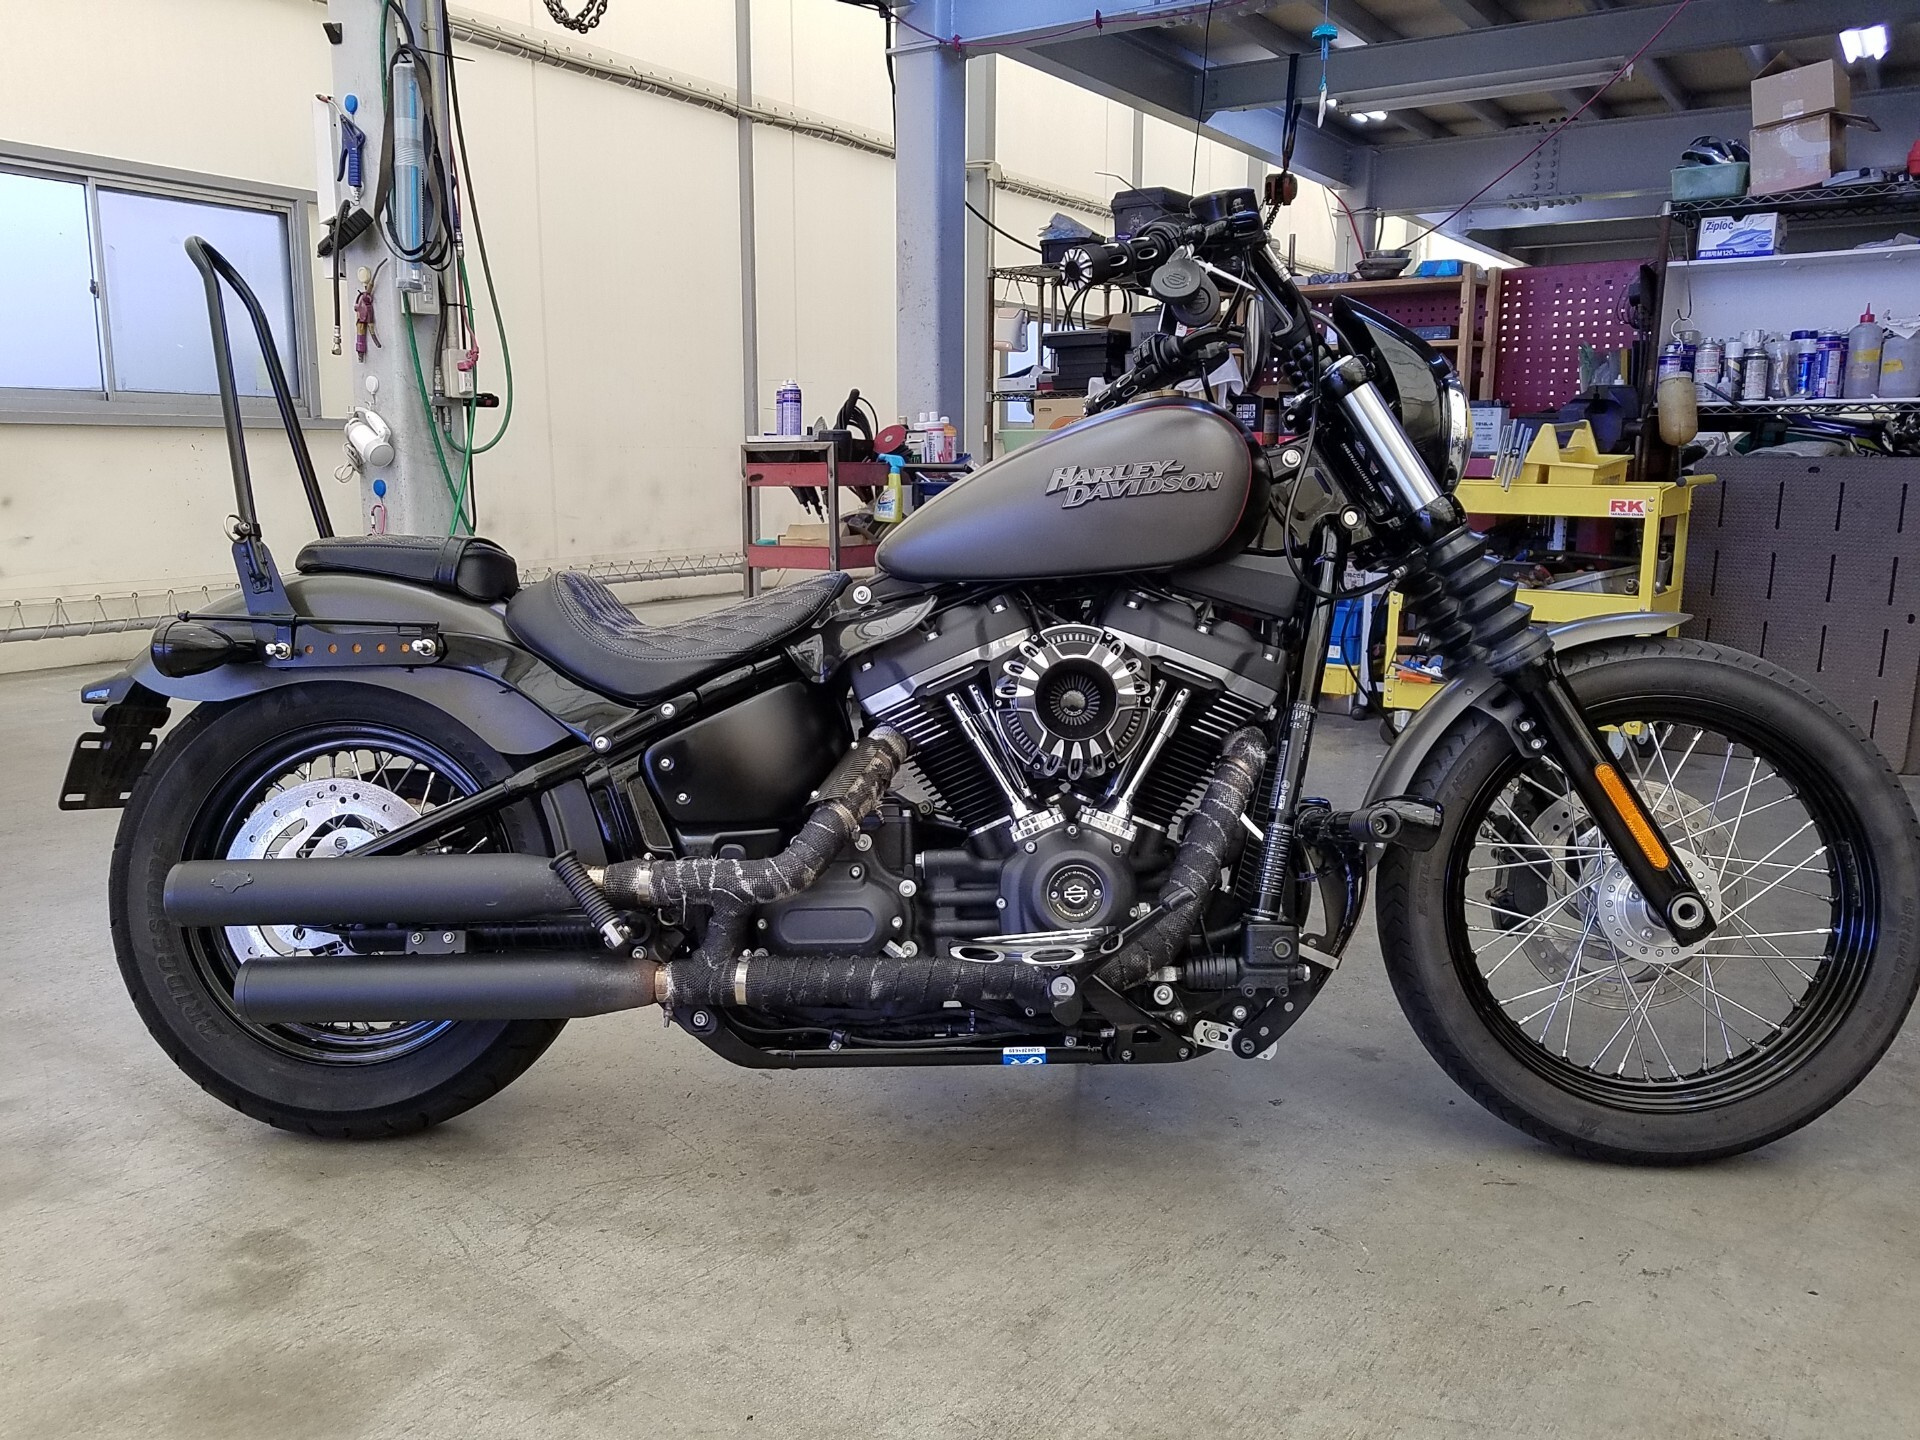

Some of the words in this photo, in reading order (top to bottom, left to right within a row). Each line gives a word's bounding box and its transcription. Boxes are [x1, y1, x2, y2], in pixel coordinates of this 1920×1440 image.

[1705, 221, 1734, 233] Ziploc
[1046, 459, 1186, 496] HARLEY-
[1062, 471, 1225, 509] DAVIDSON
[1611, 500, 1644, 513] RK
